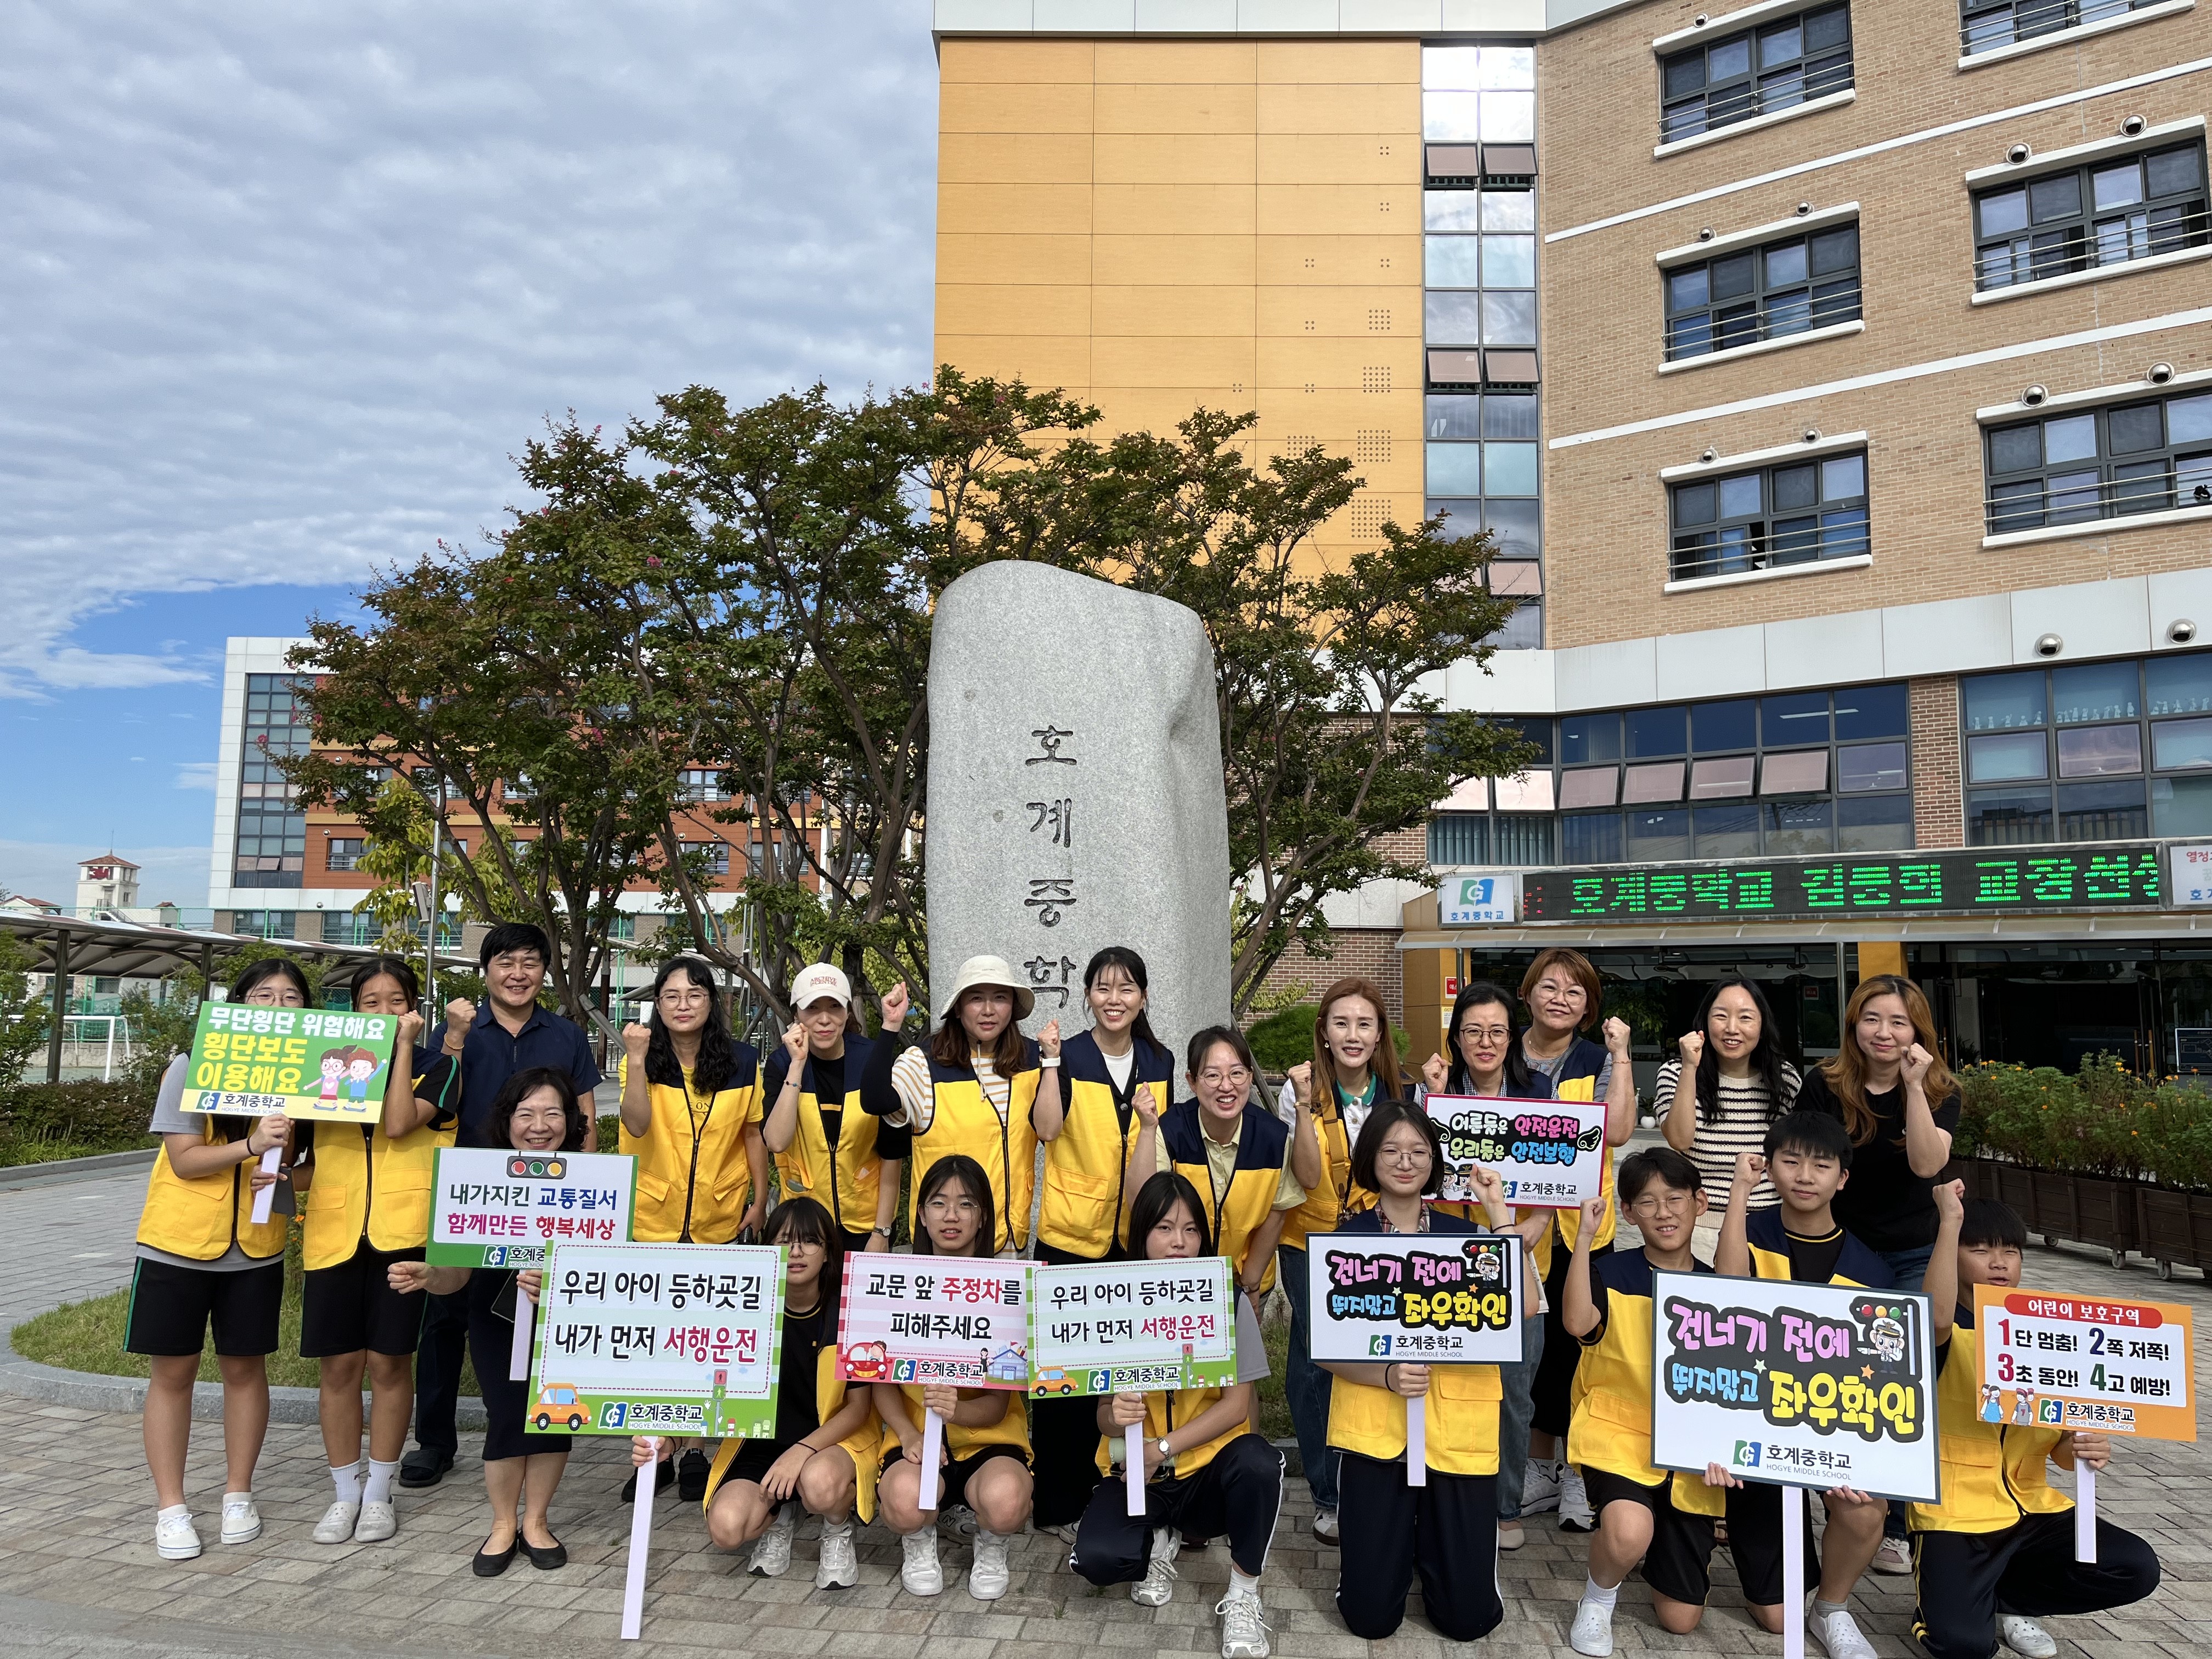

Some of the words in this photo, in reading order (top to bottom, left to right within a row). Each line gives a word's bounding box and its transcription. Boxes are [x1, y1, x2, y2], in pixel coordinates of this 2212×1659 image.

[1451, 911, 1504, 921] 호계중학교
[208, 1007, 296, 1034] 무단횡단
[301, 1013, 386, 1040] 위험해요
[202, 1032, 308, 1065] 횡단보도
[196, 1062, 301, 1094] 이용해요
[223, 1093, 285, 1108] 호계중학교
[1452, 1112, 1508, 1135] 어른들은
[1515, 1115, 1578, 1139] 안전운전
[1450, 1138, 1505, 1160] 우리들은
[1511, 1141, 1575, 1165] 안전보행
[450, 1183, 530, 1206] 내가지킨
[538, 1187, 617, 1210] 교통질서
[1520, 1182, 1577, 1195] 호계중학교
[448, 1212, 528, 1236] 함께만든
[536, 1216, 616, 1240] 행복세상
[1330, 1255, 1402, 1286] 건너기
[1412, 1256, 1462, 1286] 전에
[560, 1270, 607, 1305] 우리
[614, 1272, 661, 1302] 아이
[668, 1273, 761, 1310] 등하굣길
[865, 1273, 907, 1299] 교문
[915, 1276, 935, 1300] 앞
[941, 1277, 1022, 1306] 주정차를
[1051, 1285, 1087, 1310] 우리
[1094, 1283, 1131, 1304] 아이
[1138, 1278, 1214, 1306] 등하굣길
[1332, 1294, 1396, 1315] 뛰지말고
[1403, 1291, 1506, 1327] 좌우확인
[2028, 1299, 2073, 1318] 어린이
[2080, 1305, 2140, 1325] 보호구역
[890, 1313, 992, 1340] 피해주세요
[1052, 1322, 1090, 1343] 내가
[1097, 1319, 1133, 1344] 먼저
[1140, 1314, 1216, 1341] 서행운전
[1672, 1303, 1767, 1353] 건너기
[1781, 1314, 1850, 1362] 전에
[555, 1324, 602, 1355] 내가
[611, 1326, 656, 1359] 먼저
[664, 1325, 757, 1363] 서행운전
[1396, 1335, 1463, 1350] 호계중학교
[2038, 1331, 2078, 1352] 멈춤!
[2129, 1341, 2169, 1362] 저쪽!
[919, 1361, 983, 1378] 호계중학교
[1114, 1367, 1178, 1383] 호계중학교
[2038, 1365, 2079, 1387] 동안!
[2130, 1375, 2170, 1396] 예방!
[1672, 1362, 1759, 1402] 뛰지말고
[1769, 1370, 1915, 1435] 좌우확인
[630, 1404, 702, 1421] 호계중학교
[2067, 1403, 2135, 1423] 호계중학교
[1766, 1444, 1852, 1470] 호계중학교
[1767, 1463, 1792, 1472] HOGYE
[1793, 1466, 1820, 1476] MIDDLE
[1822, 1471, 1852, 1480] SCHOOL
